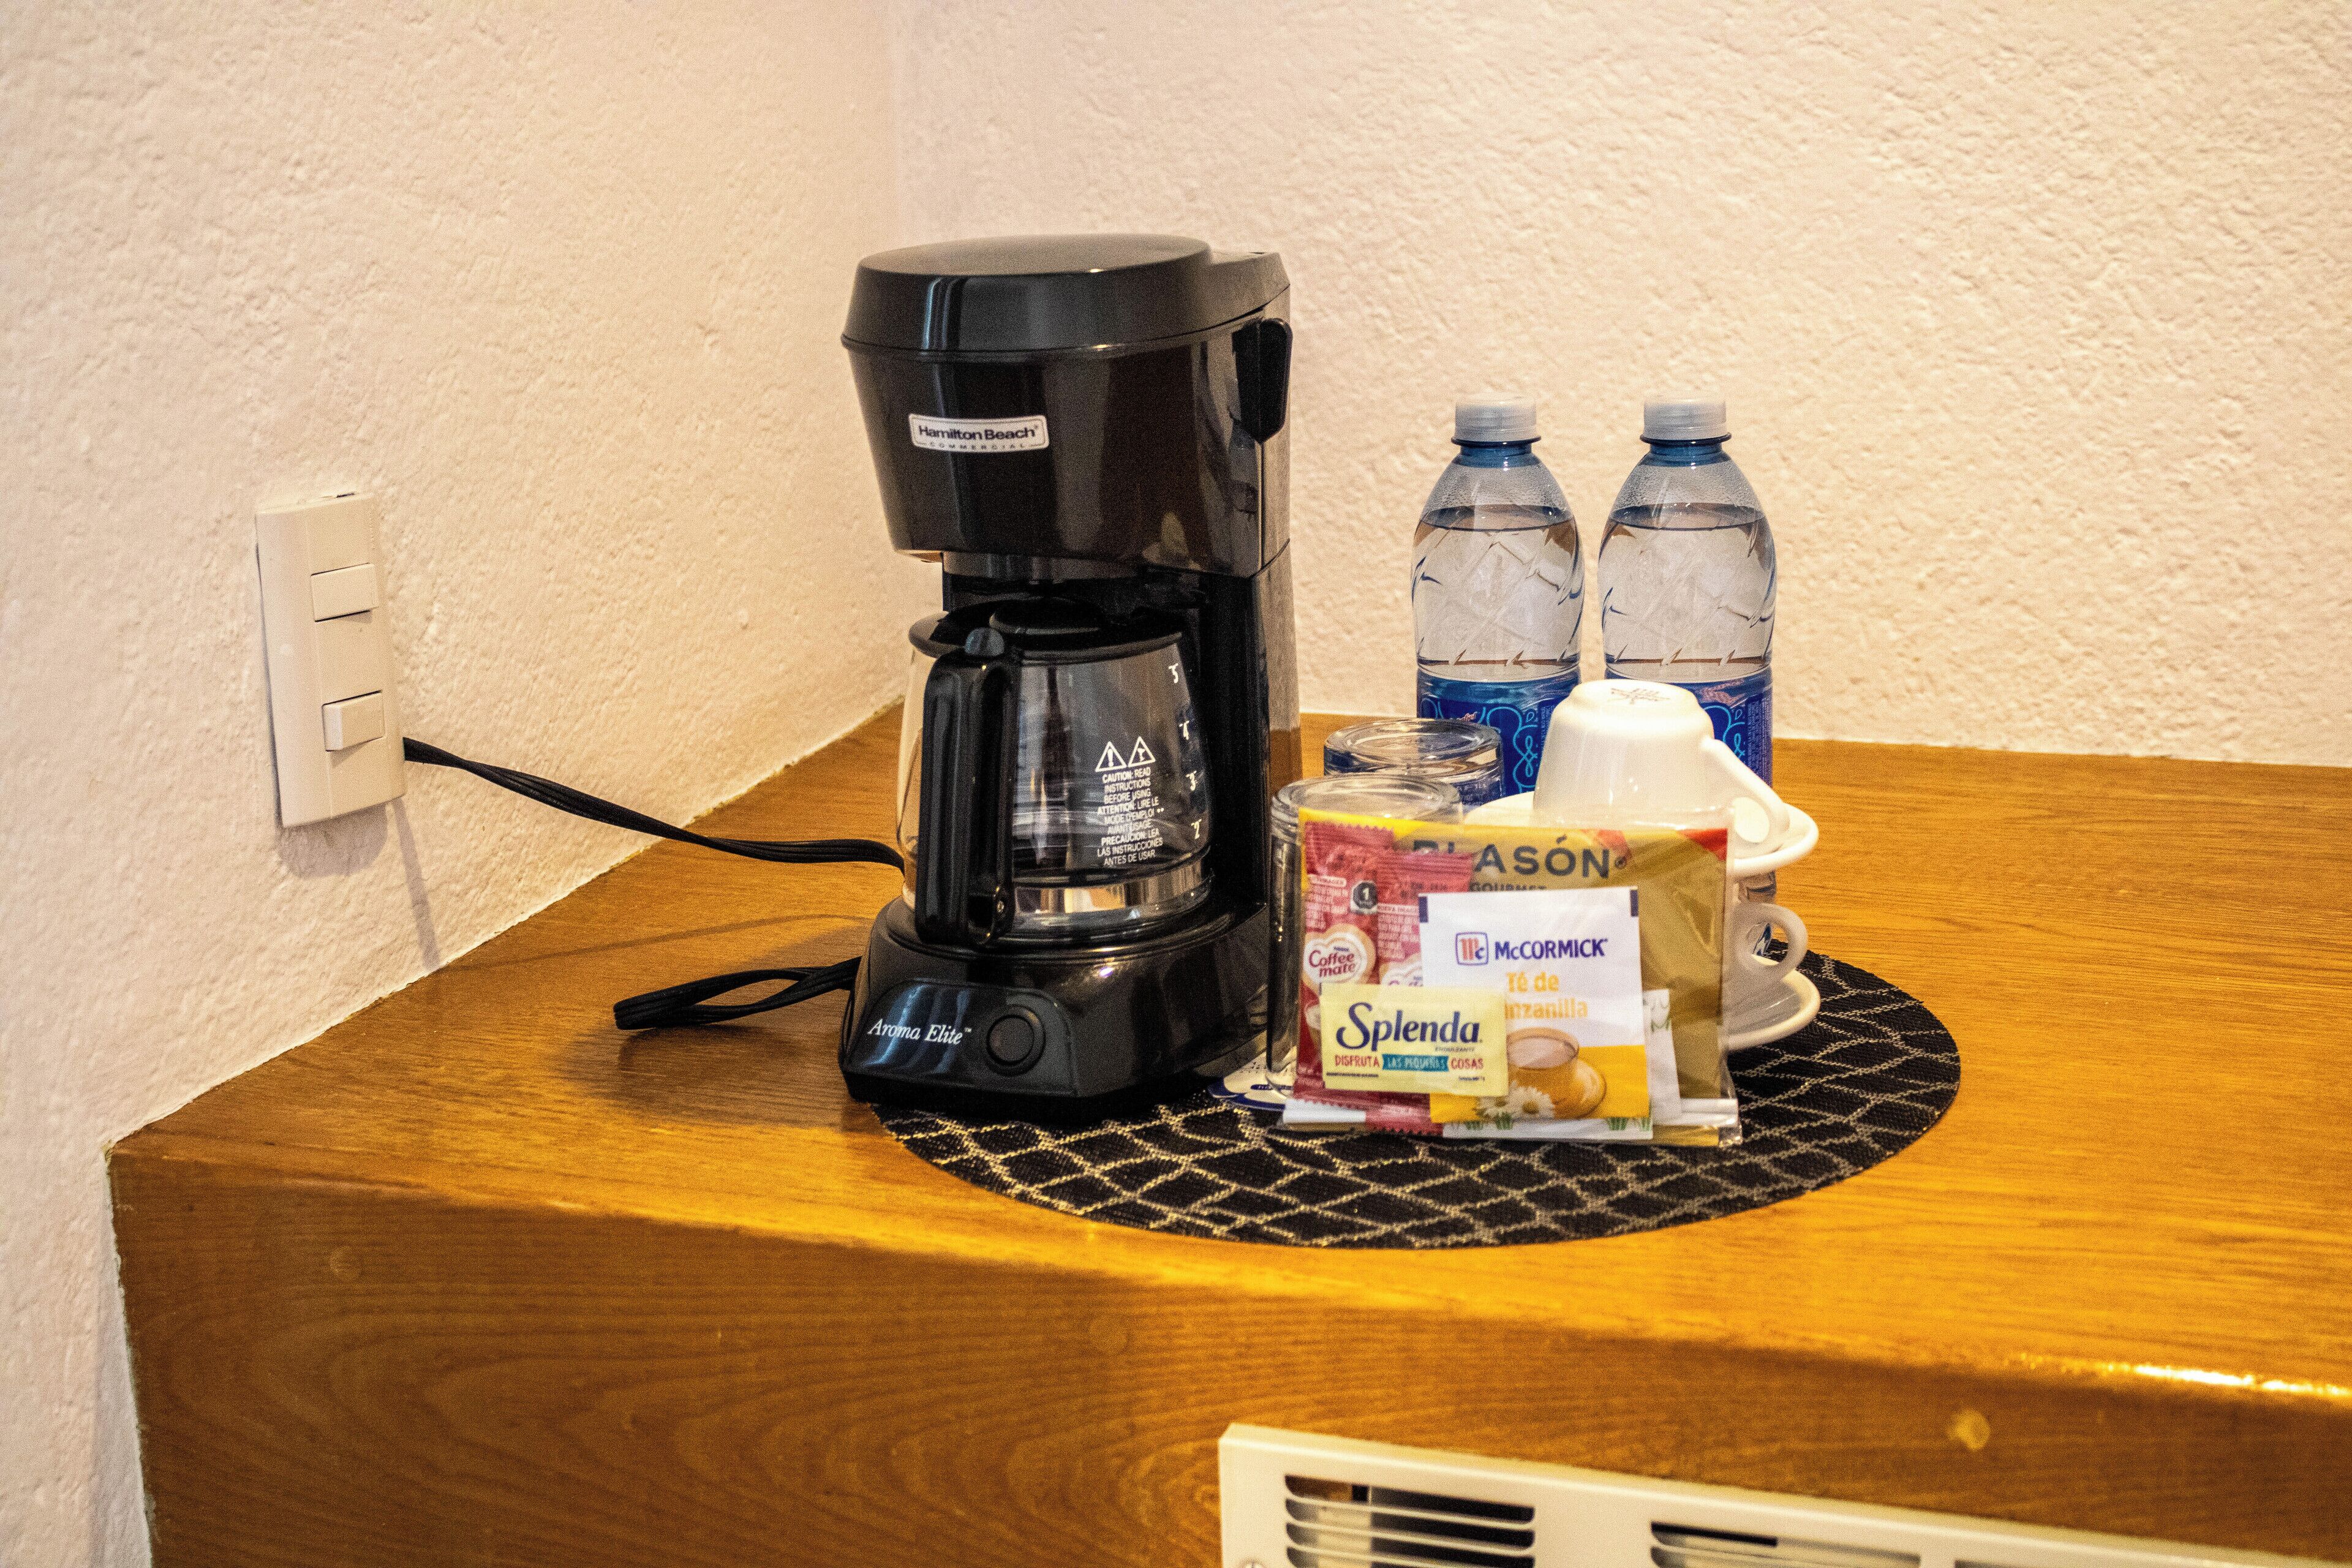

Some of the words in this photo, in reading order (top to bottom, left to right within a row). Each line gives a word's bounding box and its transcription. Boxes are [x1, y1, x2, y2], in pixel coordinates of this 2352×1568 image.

[919, 425, 982, 440] Hamilton
[929, 441, 1024, 451] COMMERCIAL
[1134, 767, 1151, 778] READ
[1104, 778, 1151, 794] INSTRUCTIONS
[1104, 792, 1131, 804] BEFORE
[1152, 796, 1159, 807] LE
[1097, 846, 1110, 858] LAS
[1112, 837, 1163, 854] INSTRUCCIONES
[1104, 855, 1126, 866] ANTES
[1128, 853, 1137, 863] DE
[1139, 849, 1156, 861] USAR
[1413, 834, 1610, 879] ASÓN
[1362, 887, 1370, 901] 1
[1309, 950, 1355, 968] Coffee
[1319, 962, 1356, 978] mate
[1506, 971, 1528, 993] Té
[1533, 971, 1560, 993] de
[1505, 997, 1588, 1020] nzanilla
[868, 1018, 921, 1040] Aroma
[1336, 1001, 1481, 1052] Splenda
[1335, 1054, 1380, 1068] DISFRUTA
[1387, 1057, 1402, 1068] LAS
[1450, 1057, 1483, 1069] COSAS
